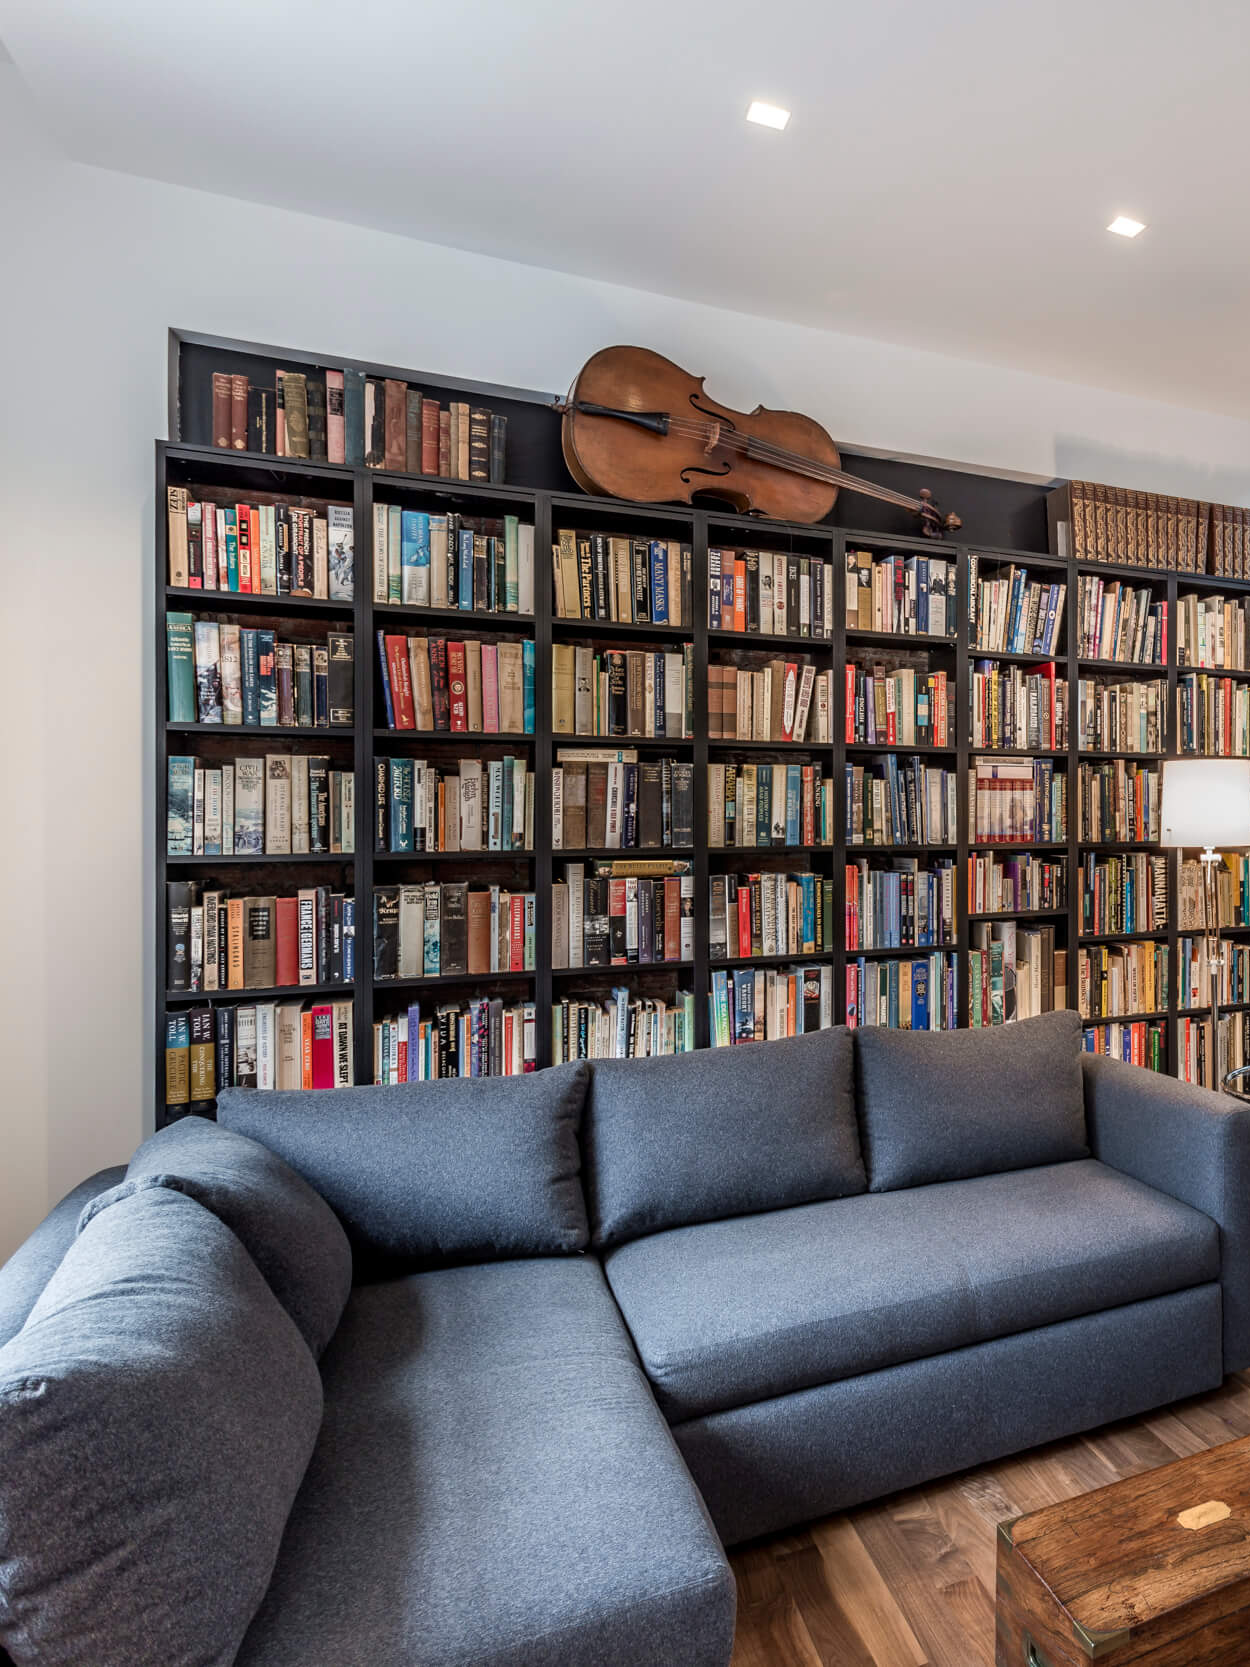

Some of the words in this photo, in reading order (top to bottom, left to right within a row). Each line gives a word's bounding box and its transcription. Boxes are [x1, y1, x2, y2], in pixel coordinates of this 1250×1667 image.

[581, 558, 592, 573] The
[654, 562, 664, 586] MANY
[789, 566, 797, 580] IKE
[582, 574, 592, 607] Partners
[655, 586, 665, 611] MASKS
[378, 763, 386, 792] CHARMED
[1154, 859, 1167, 926] MANNAHATTA
[206, 896, 217, 923] OVERLORD
[301, 901, 313, 929] FRANCE
[232, 925, 240, 968] STALINGRAD
[300, 933, 313, 969] GERMANS
[168, 1020, 176, 1041] TOLL
[178, 1017, 186, 1031] IAN
[193, 1017, 201, 1038] TOLL
[202, 1014, 210, 1028] IAN
[337, 1022, 348, 1030] AT
[202, 1031, 210, 1040] W.
[338, 1031, 348, 1052] DAWN
[338, 1052, 348, 1065] WE
[339, 1065, 349, 1083] SLEPT
